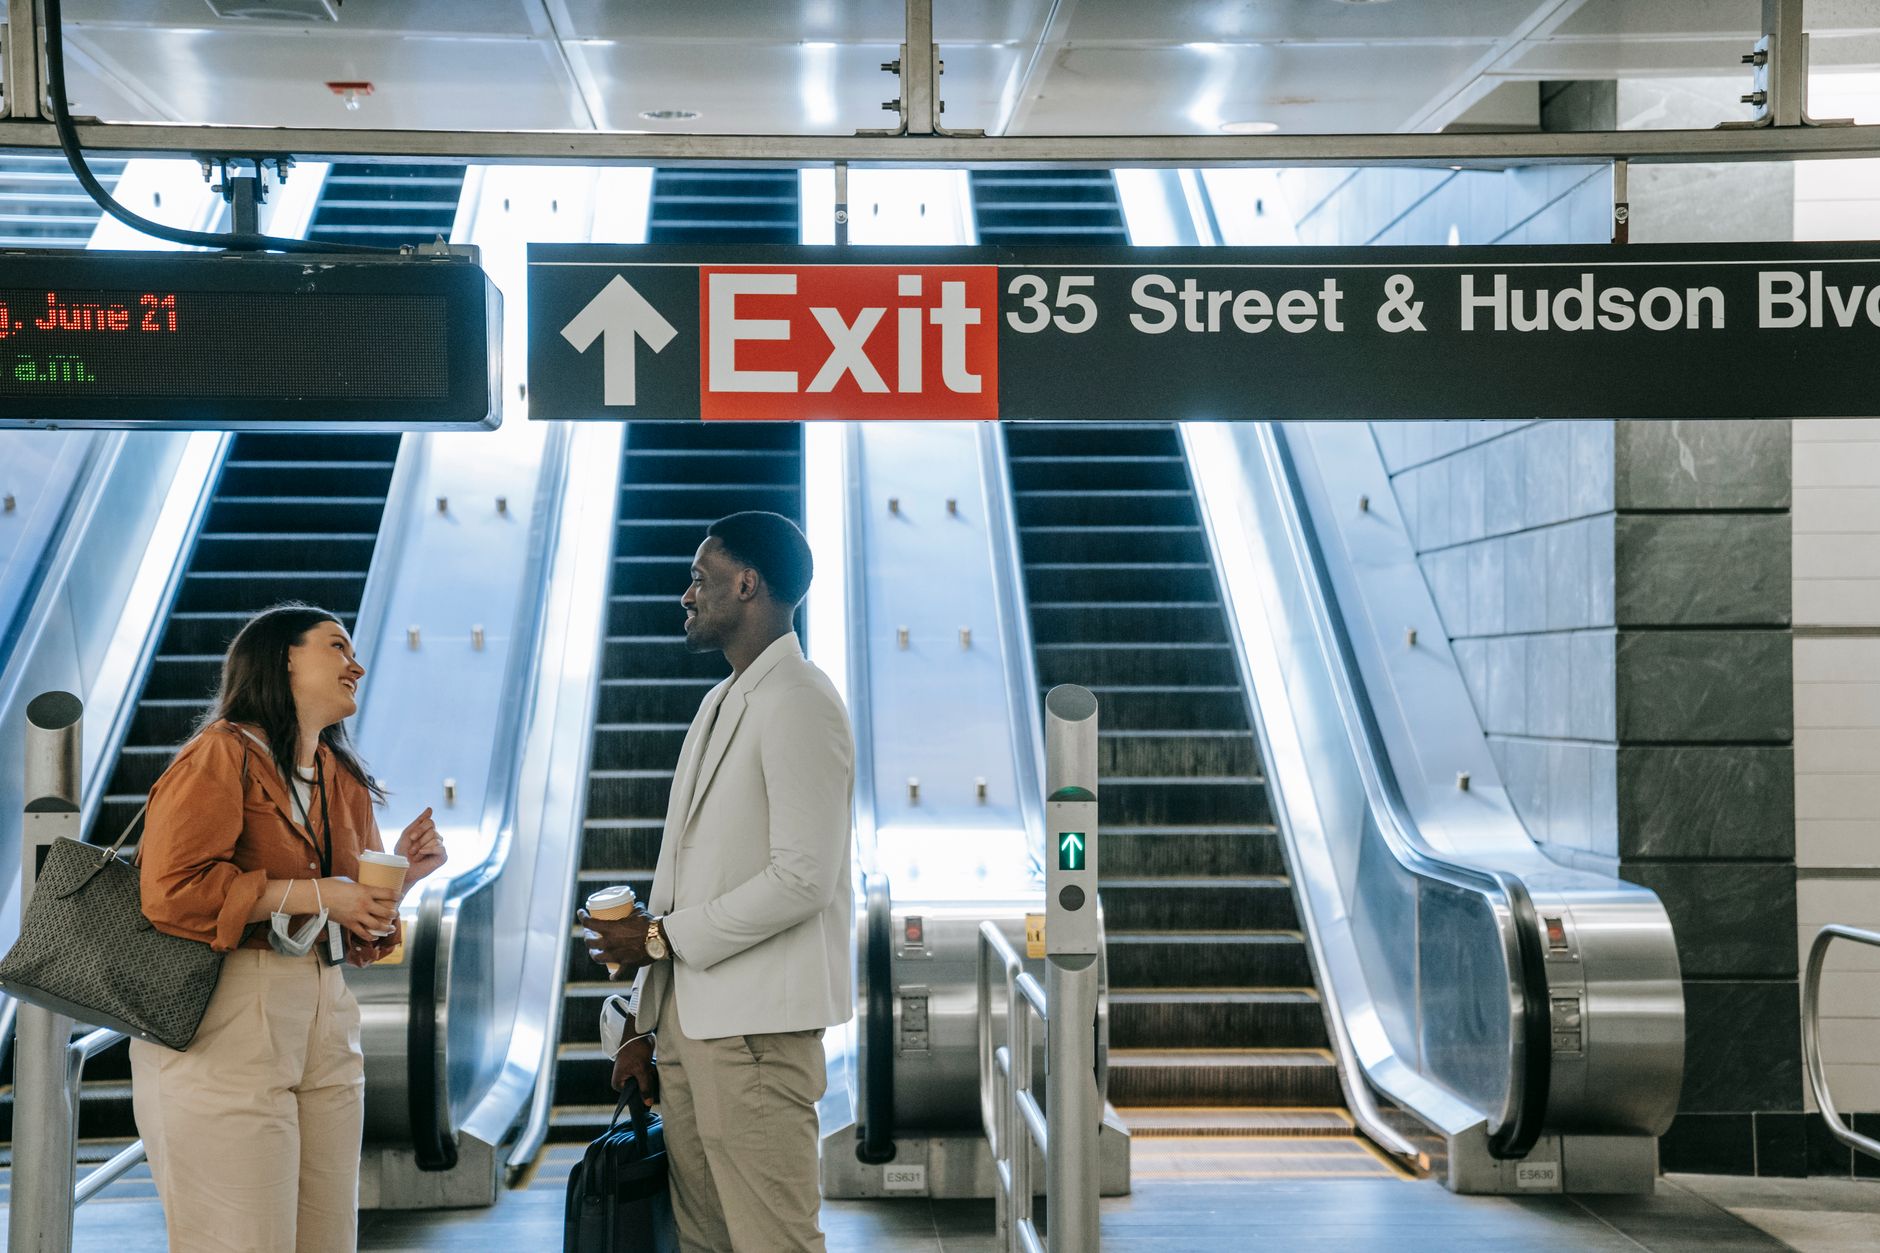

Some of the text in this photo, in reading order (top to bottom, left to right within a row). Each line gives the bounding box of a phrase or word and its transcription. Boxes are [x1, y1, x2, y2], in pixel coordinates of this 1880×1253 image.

[35, 292, 129, 331] June
[140, 294, 178, 332] 21
[1006, 274, 1098, 334] 35
[1129, 273, 1345, 334] Street
[1376, 273, 1428, 333] &
[1460, 273, 1725, 332] Hudson
[708, 273, 982, 393] Exit
[14, 354, 95, 381] a.m.
[887, 1172, 921, 1183] ES631
[1519, 1169, 1554, 1180] ES630
